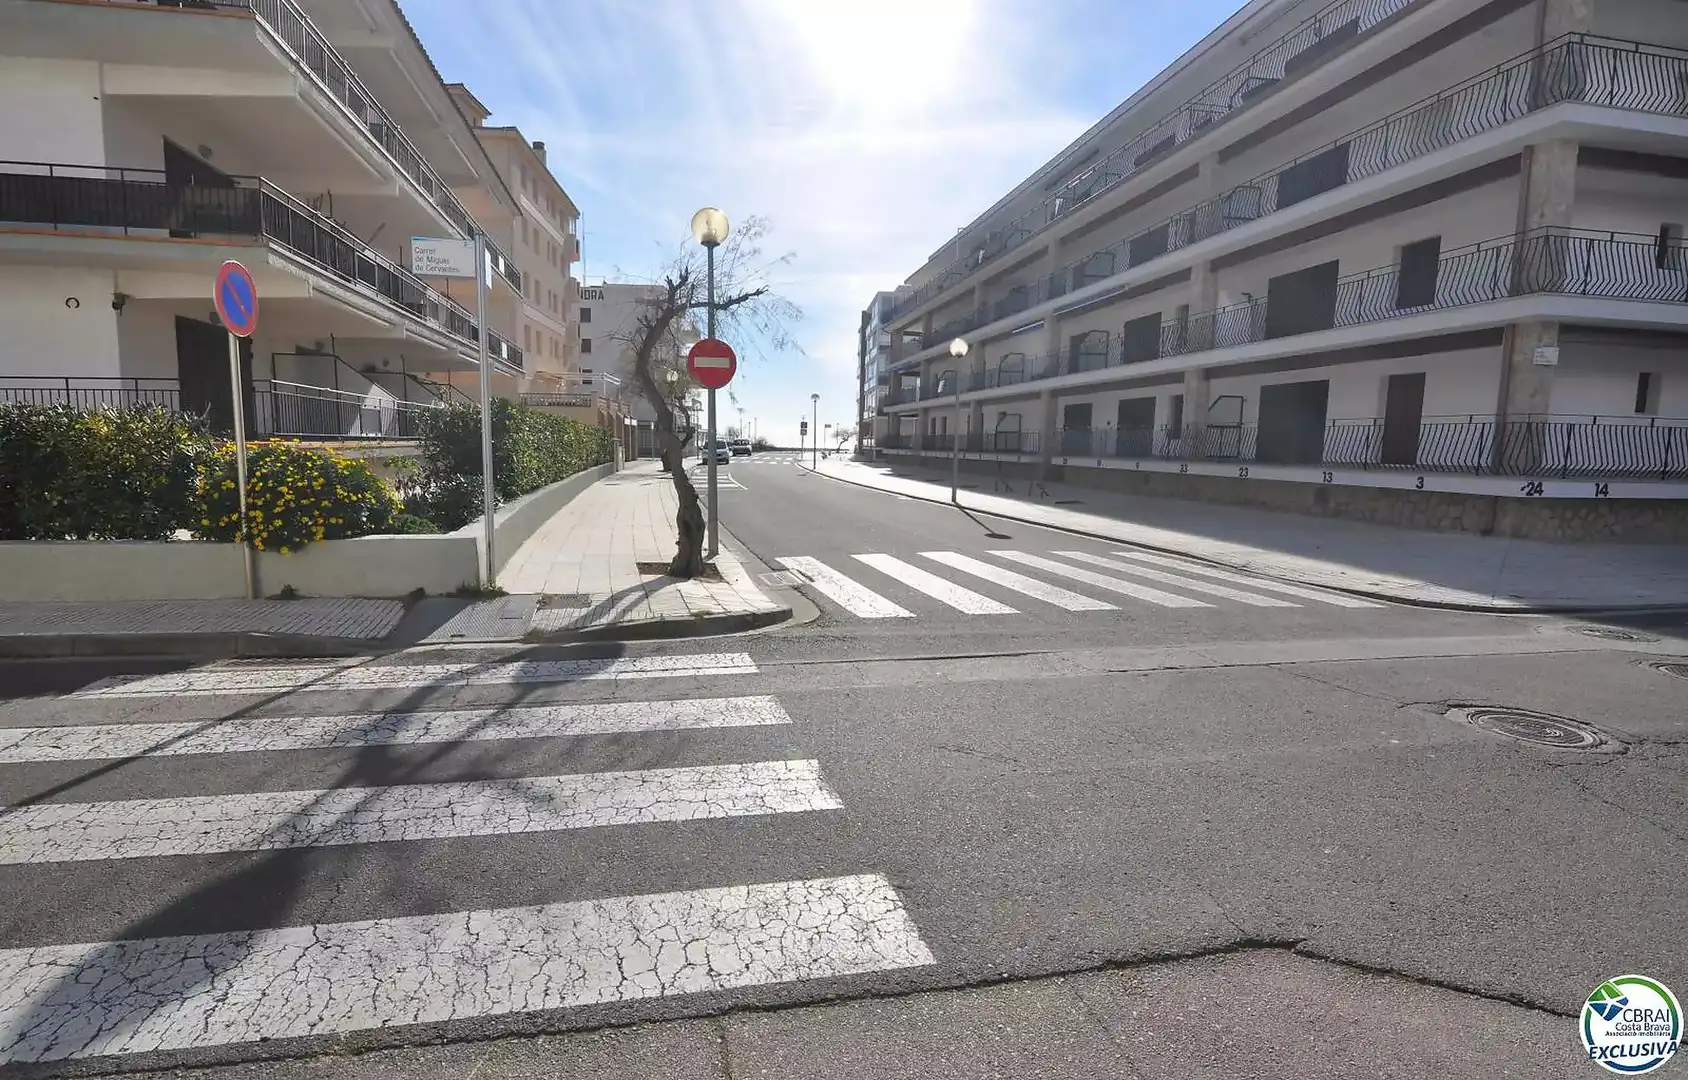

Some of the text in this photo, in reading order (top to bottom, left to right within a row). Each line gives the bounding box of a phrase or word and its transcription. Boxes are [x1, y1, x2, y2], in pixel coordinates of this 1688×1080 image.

[1238, 467, 1249, 477] 23
[1322, 471, 1333, 482] 13
[1416, 477, 1424, 490] 3
[1594, 482, 1609, 497] 14
